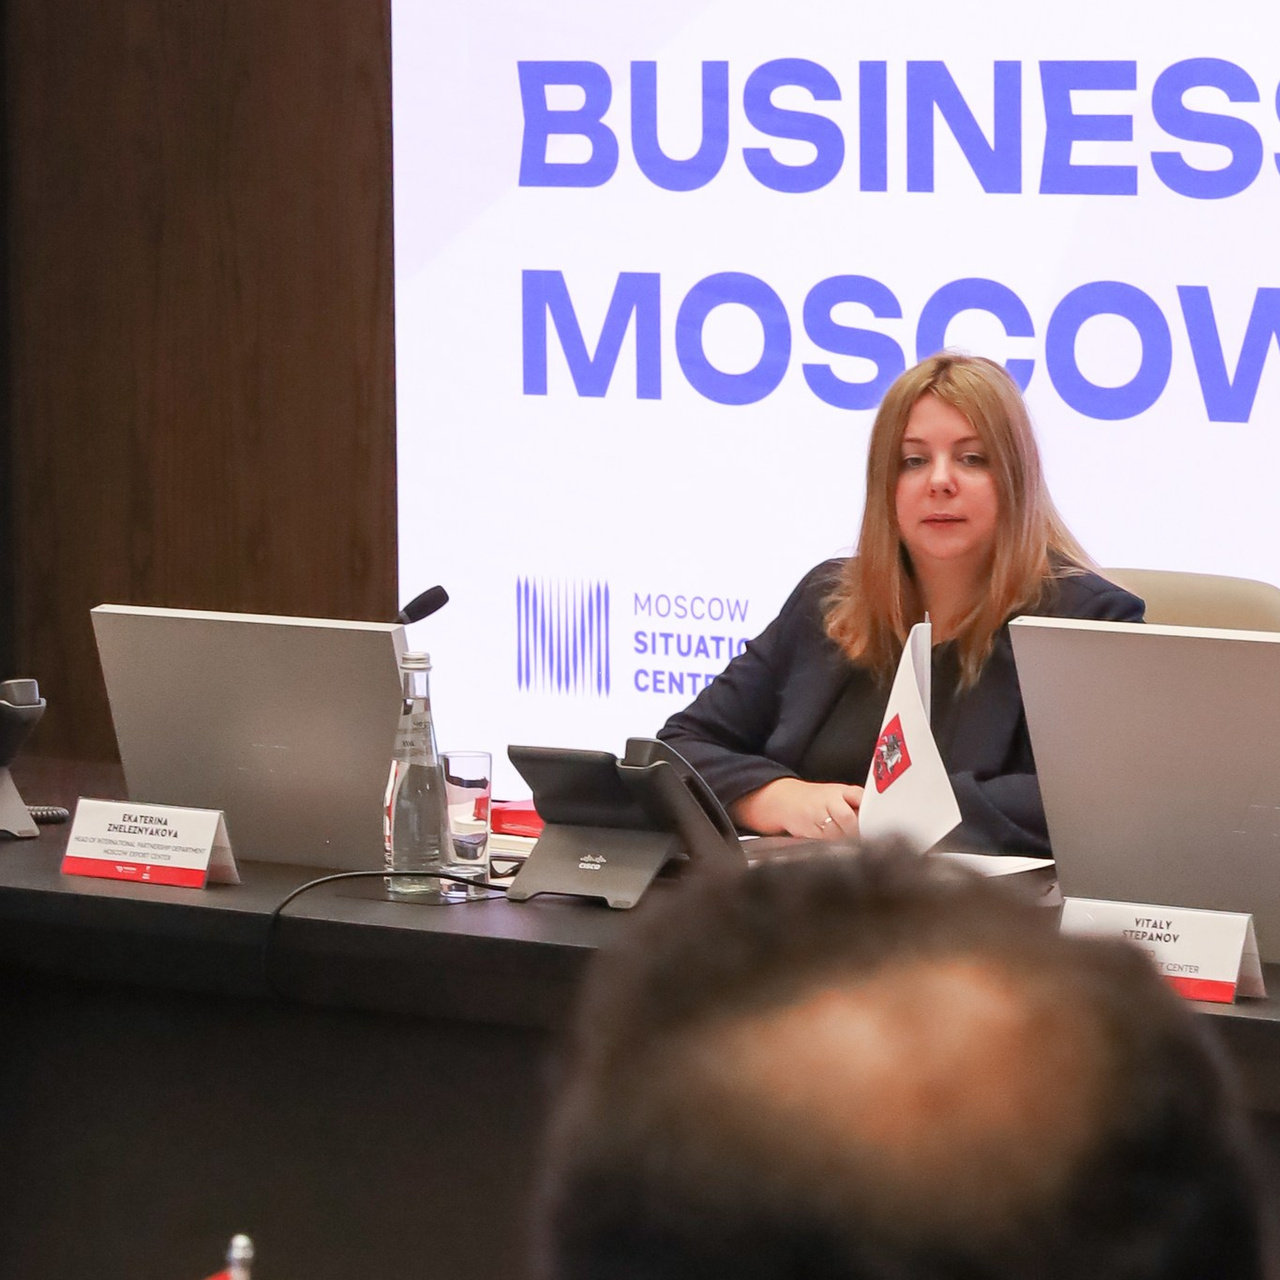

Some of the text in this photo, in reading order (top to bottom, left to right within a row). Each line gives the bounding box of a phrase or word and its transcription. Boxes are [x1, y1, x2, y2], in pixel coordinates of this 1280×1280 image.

[634, 592, 749, 623] MOSCOW
[122, 813, 168, 826] EKATERINA
[107, 823, 178, 839] ZHELEZNYAKOVA
[1134, 917, 1173, 930] VITALY
[1122, 929, 1180, 943] STEPANOV
